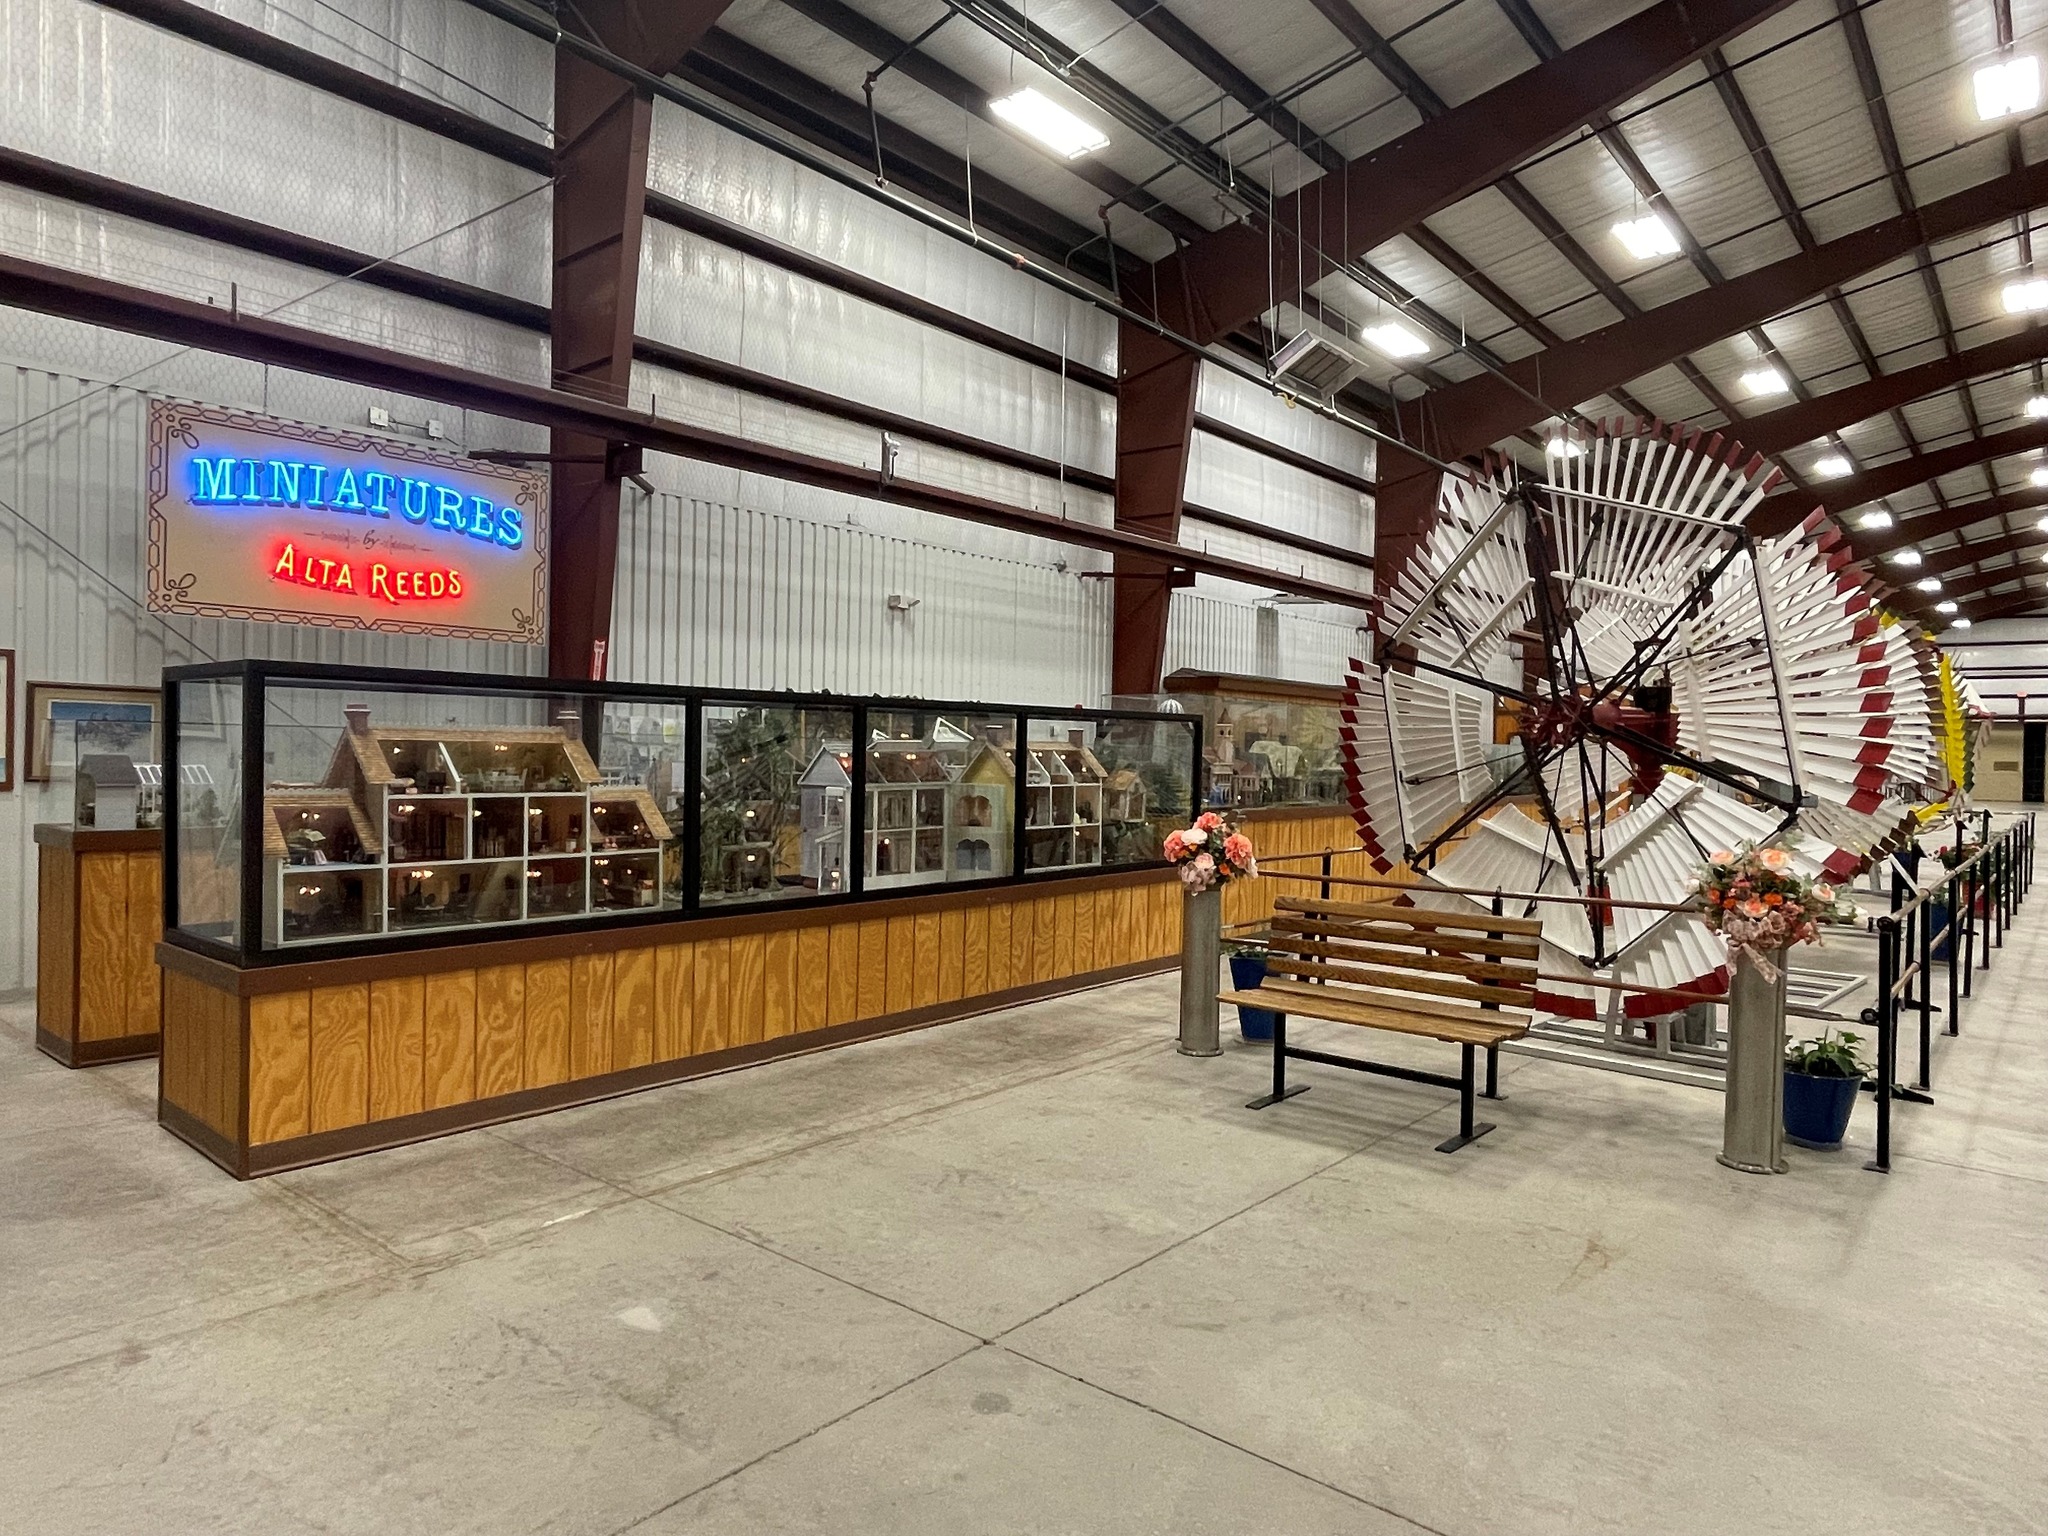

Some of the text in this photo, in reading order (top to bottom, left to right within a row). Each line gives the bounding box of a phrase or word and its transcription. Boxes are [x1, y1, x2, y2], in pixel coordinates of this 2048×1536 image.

[191, 457, 524, 547] MINIATURES
[363, 529, 381, 549] by
[274, 543, 464, 604] ALTA REEDS
